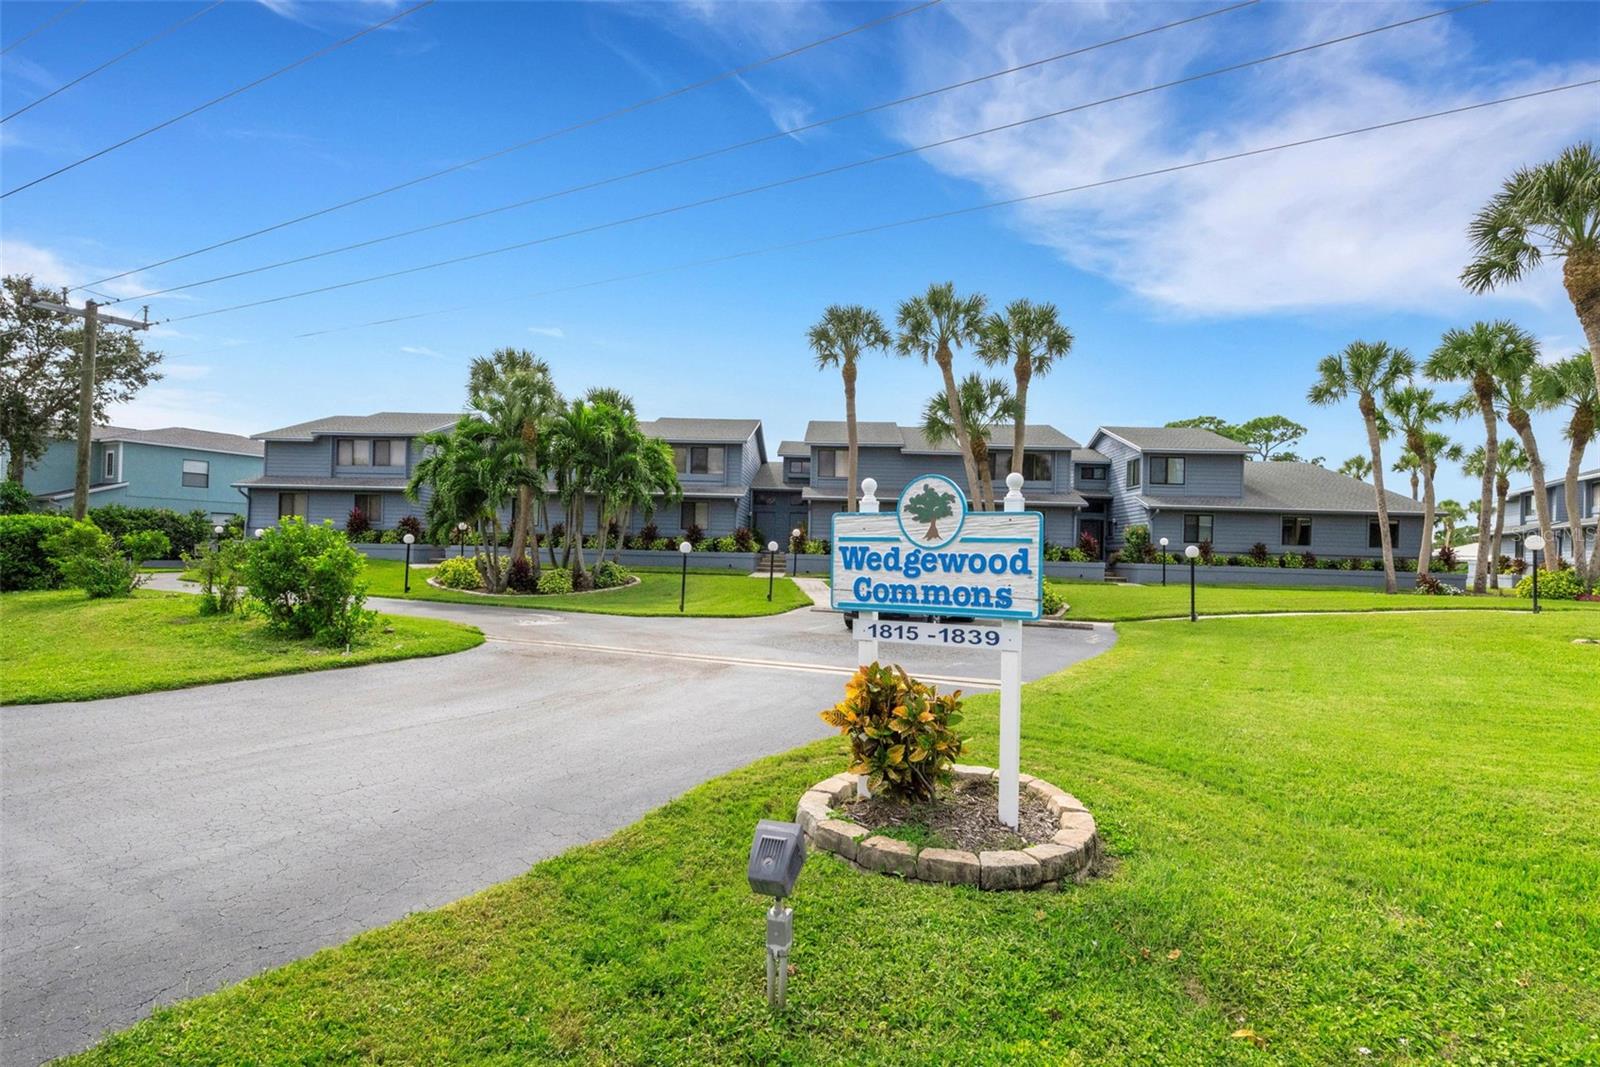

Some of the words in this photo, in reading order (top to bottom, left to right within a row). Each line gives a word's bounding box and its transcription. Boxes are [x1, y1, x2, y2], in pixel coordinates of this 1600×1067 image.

[838, 546, 1032, 578] Wedgewood
[853, 577, 1013, 609] Commons
[868, 623, 919, 641] 1815
